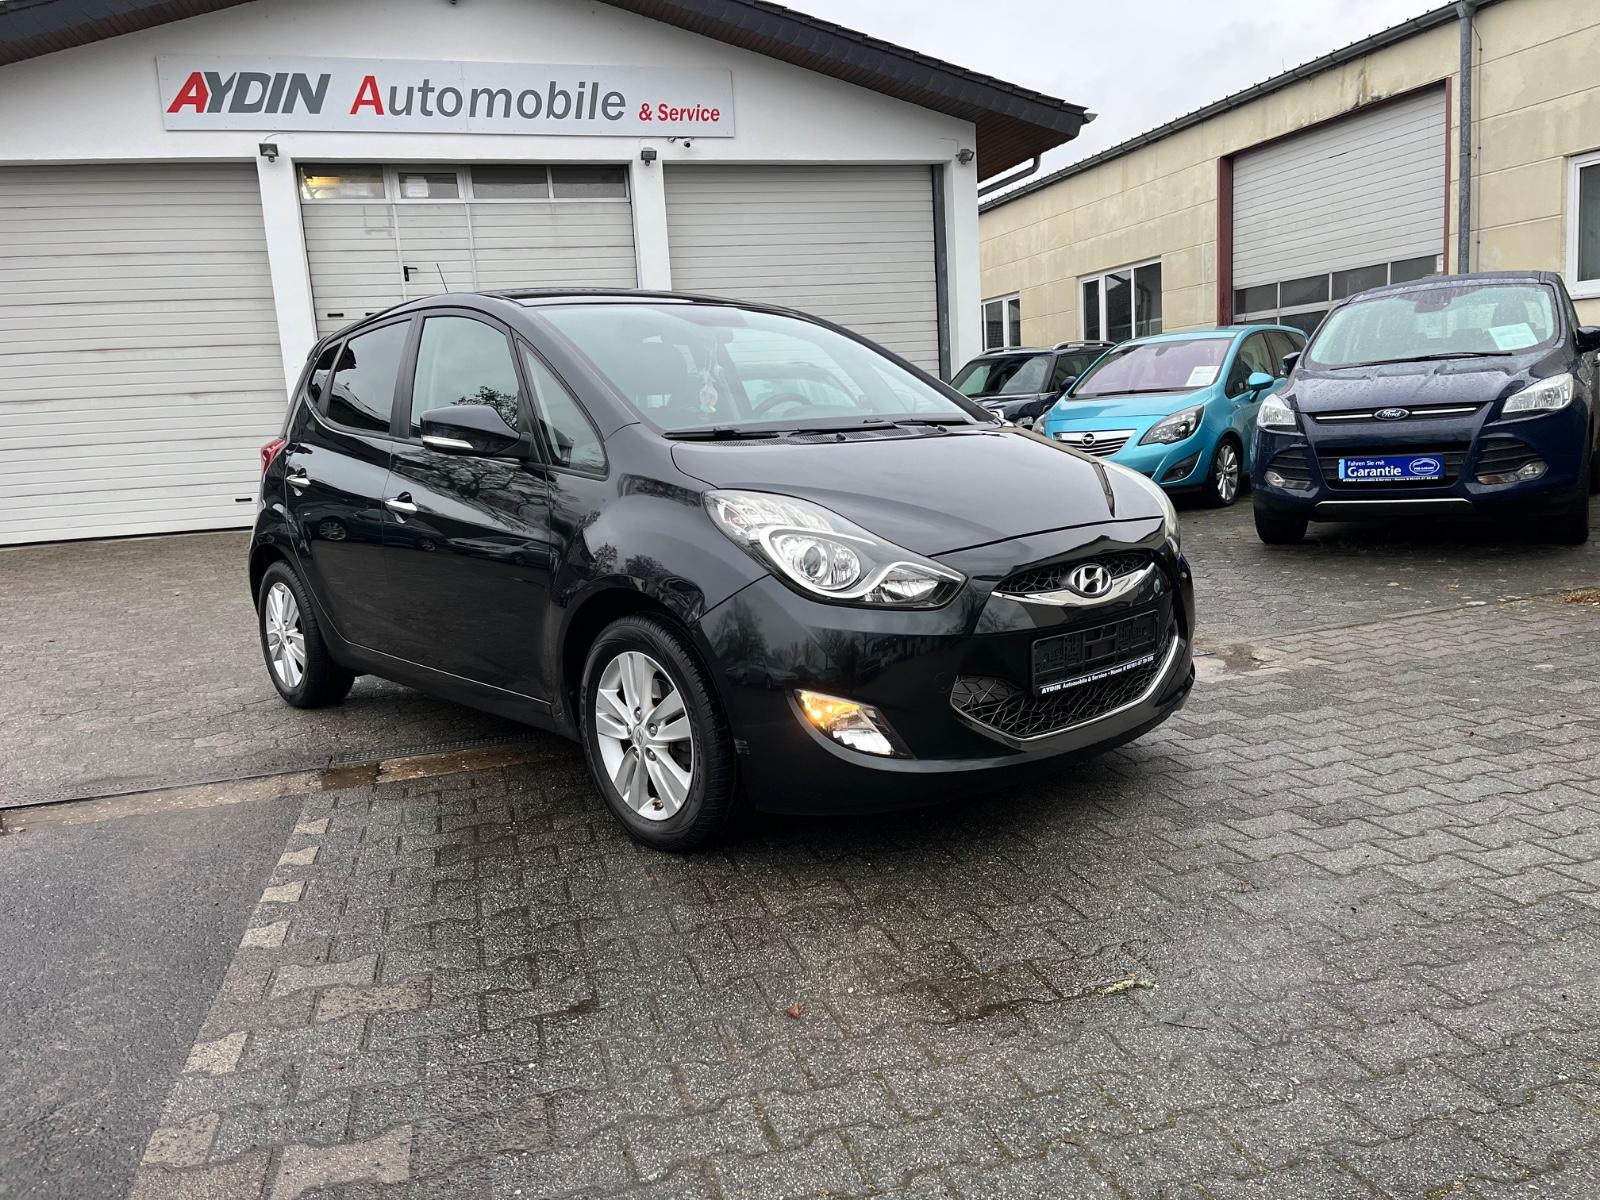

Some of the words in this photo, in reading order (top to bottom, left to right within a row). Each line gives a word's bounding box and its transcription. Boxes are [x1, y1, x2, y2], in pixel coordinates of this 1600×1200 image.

[166, 71, 332, 114] AYDIN
[349, 75, 626, 121] Automobile
[638, 103, 652, 122] &
[657, 103, 721, 122] Service
[1347, 465, 1402, 477] Garantie
[1041, 685, 1061, 694] AYDIN
